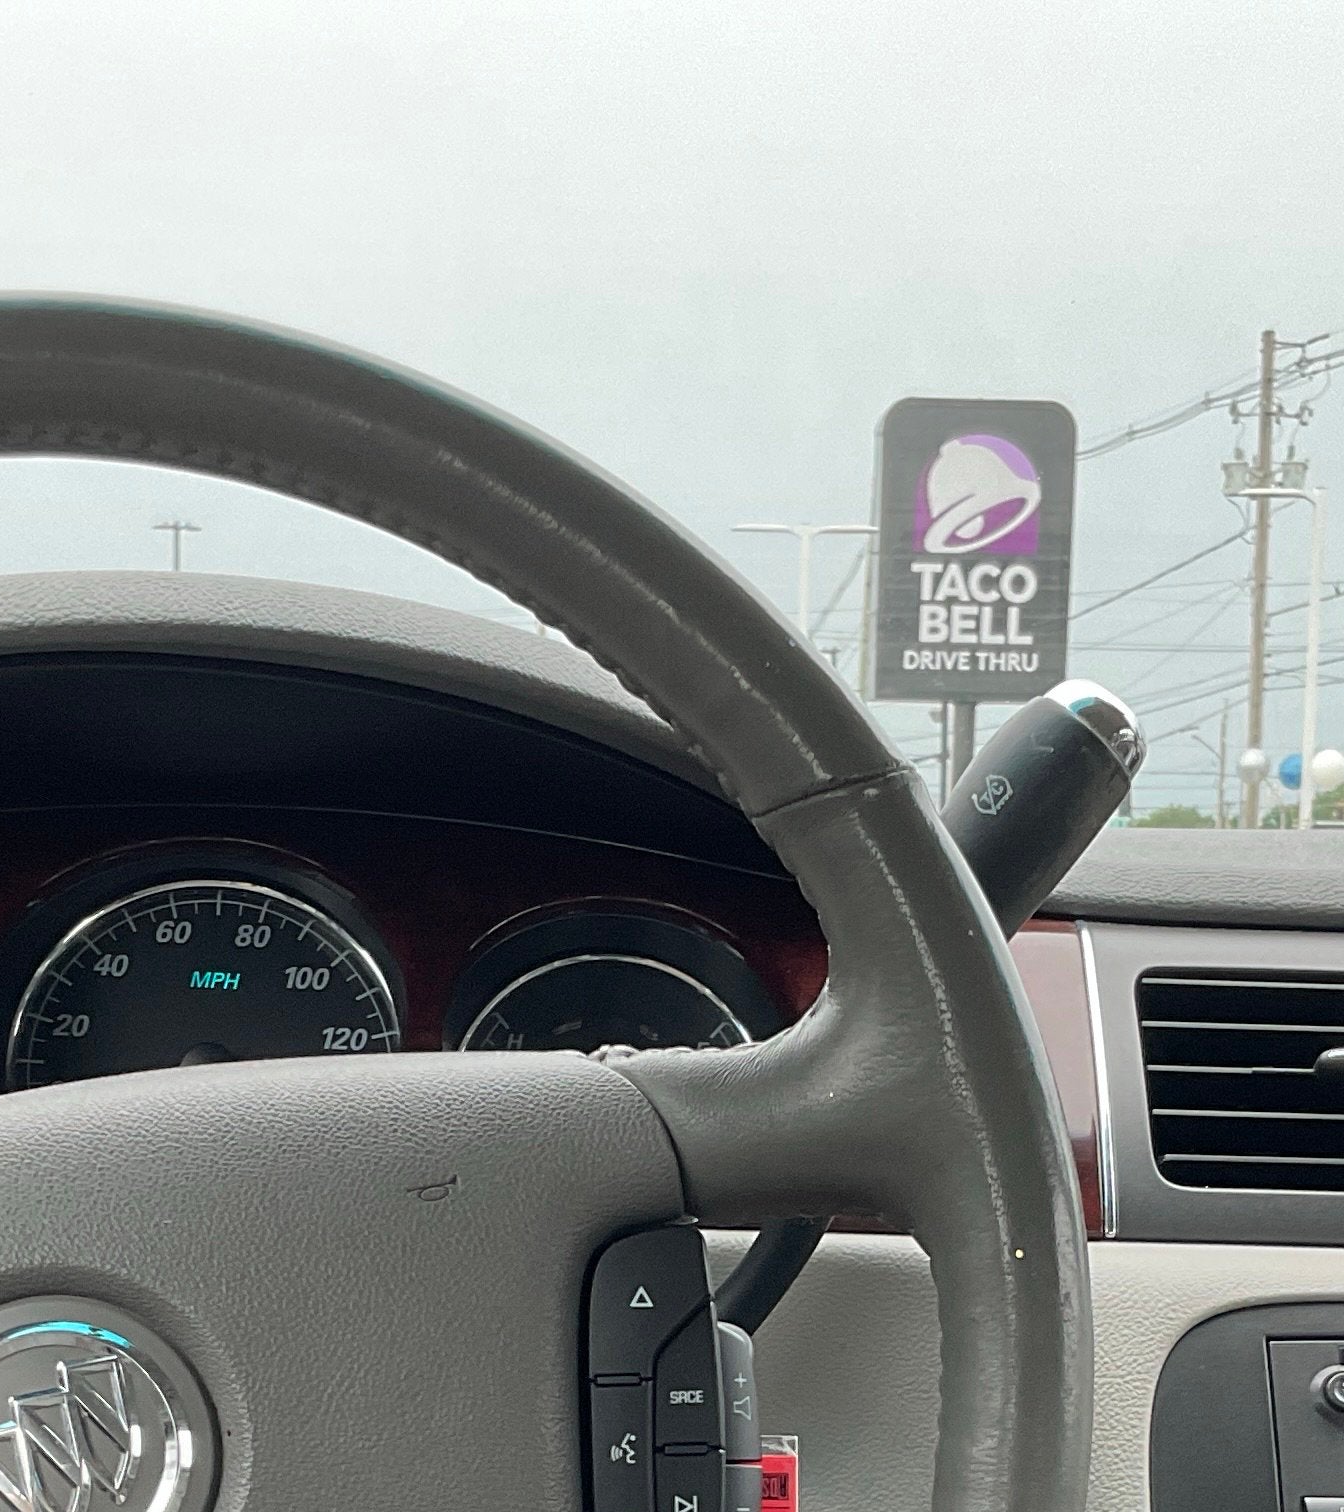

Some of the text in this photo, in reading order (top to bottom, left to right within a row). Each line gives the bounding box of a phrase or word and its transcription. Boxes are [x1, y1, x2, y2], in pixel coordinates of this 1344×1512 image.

[910, 563, 1038, 602] TACO
[917, 605, 1034, 645] BELL
[902, 650, 1039, 672] DRIVE THRU
[156, 921, 191, 945] 60
[234, 924, 271, 949] 80
[93, 953, 129, 978] 40
[285, 965, 330, 991] 100
[189, 970, 241, 991] MPH
[52, 1013, 91, 1038] 20
[322, 1026, 368, 1051] 120
[506, 1033, 525, 1049] H
[669, 1391, 704, 1404] SRCE
